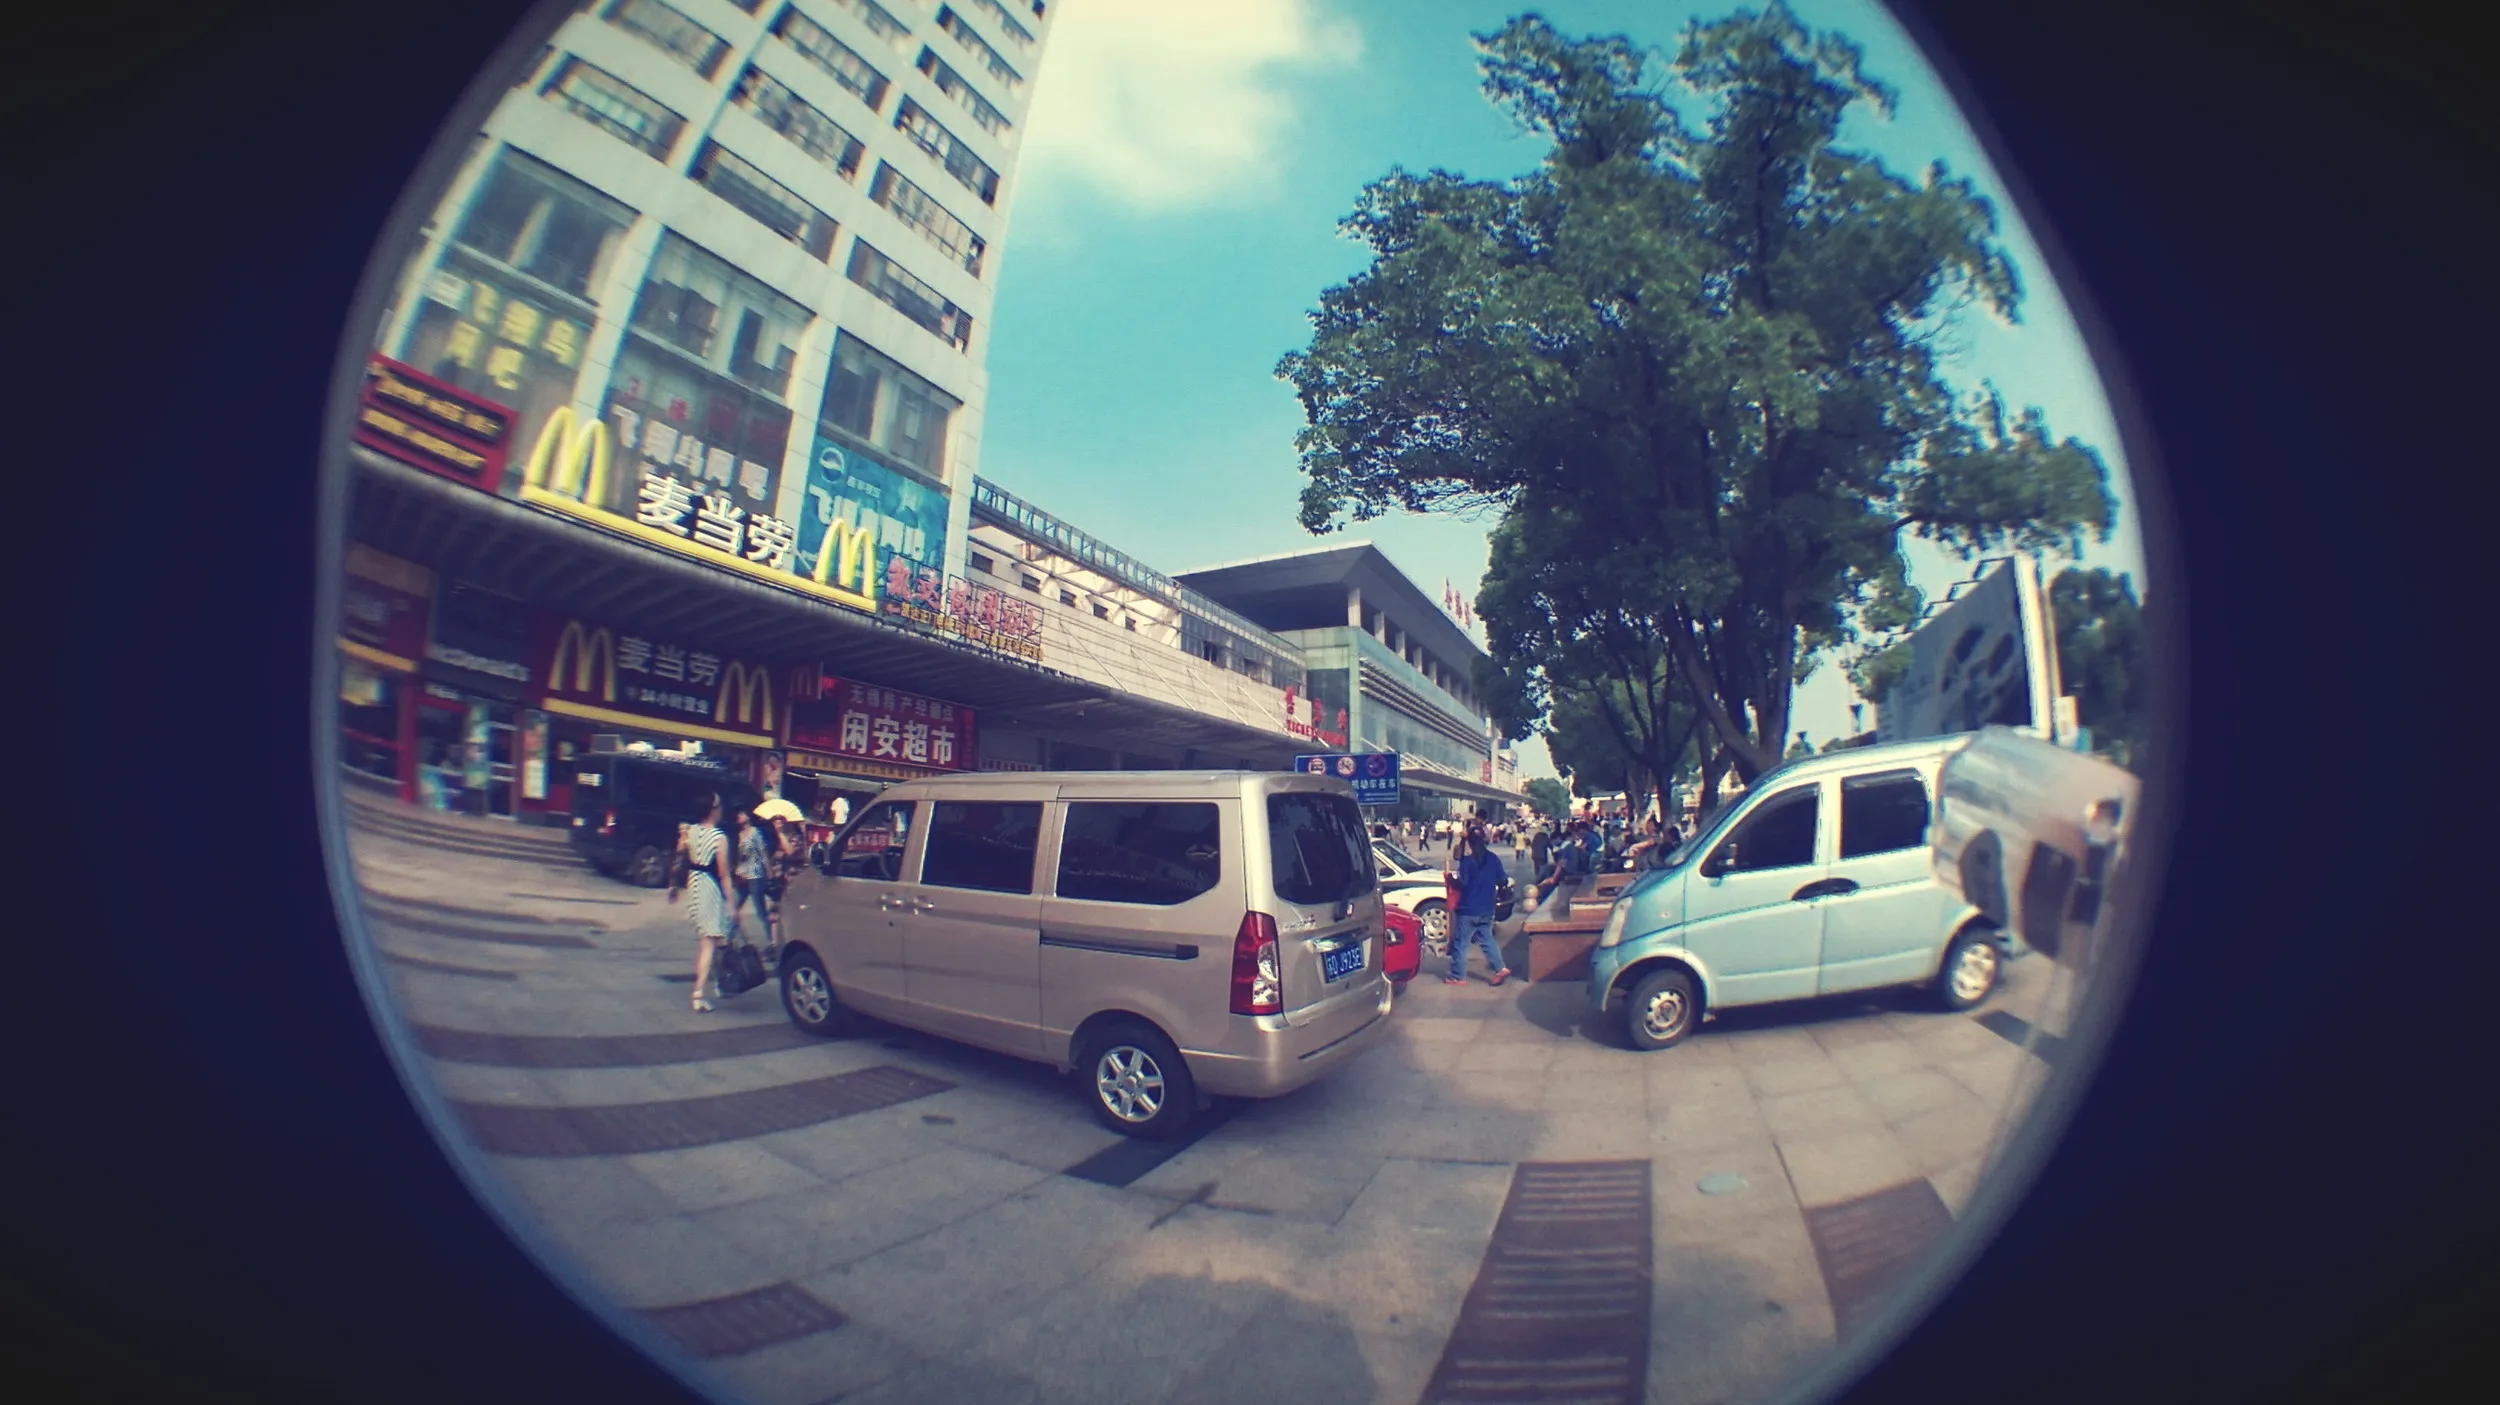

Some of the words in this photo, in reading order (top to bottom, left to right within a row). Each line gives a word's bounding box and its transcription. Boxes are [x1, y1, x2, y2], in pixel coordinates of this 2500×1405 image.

[637, 472, 797, 570] 麦当劳
[617, 635, 722, 687] 麦当劳
[839, 710, 956, 766] 闲安超市
